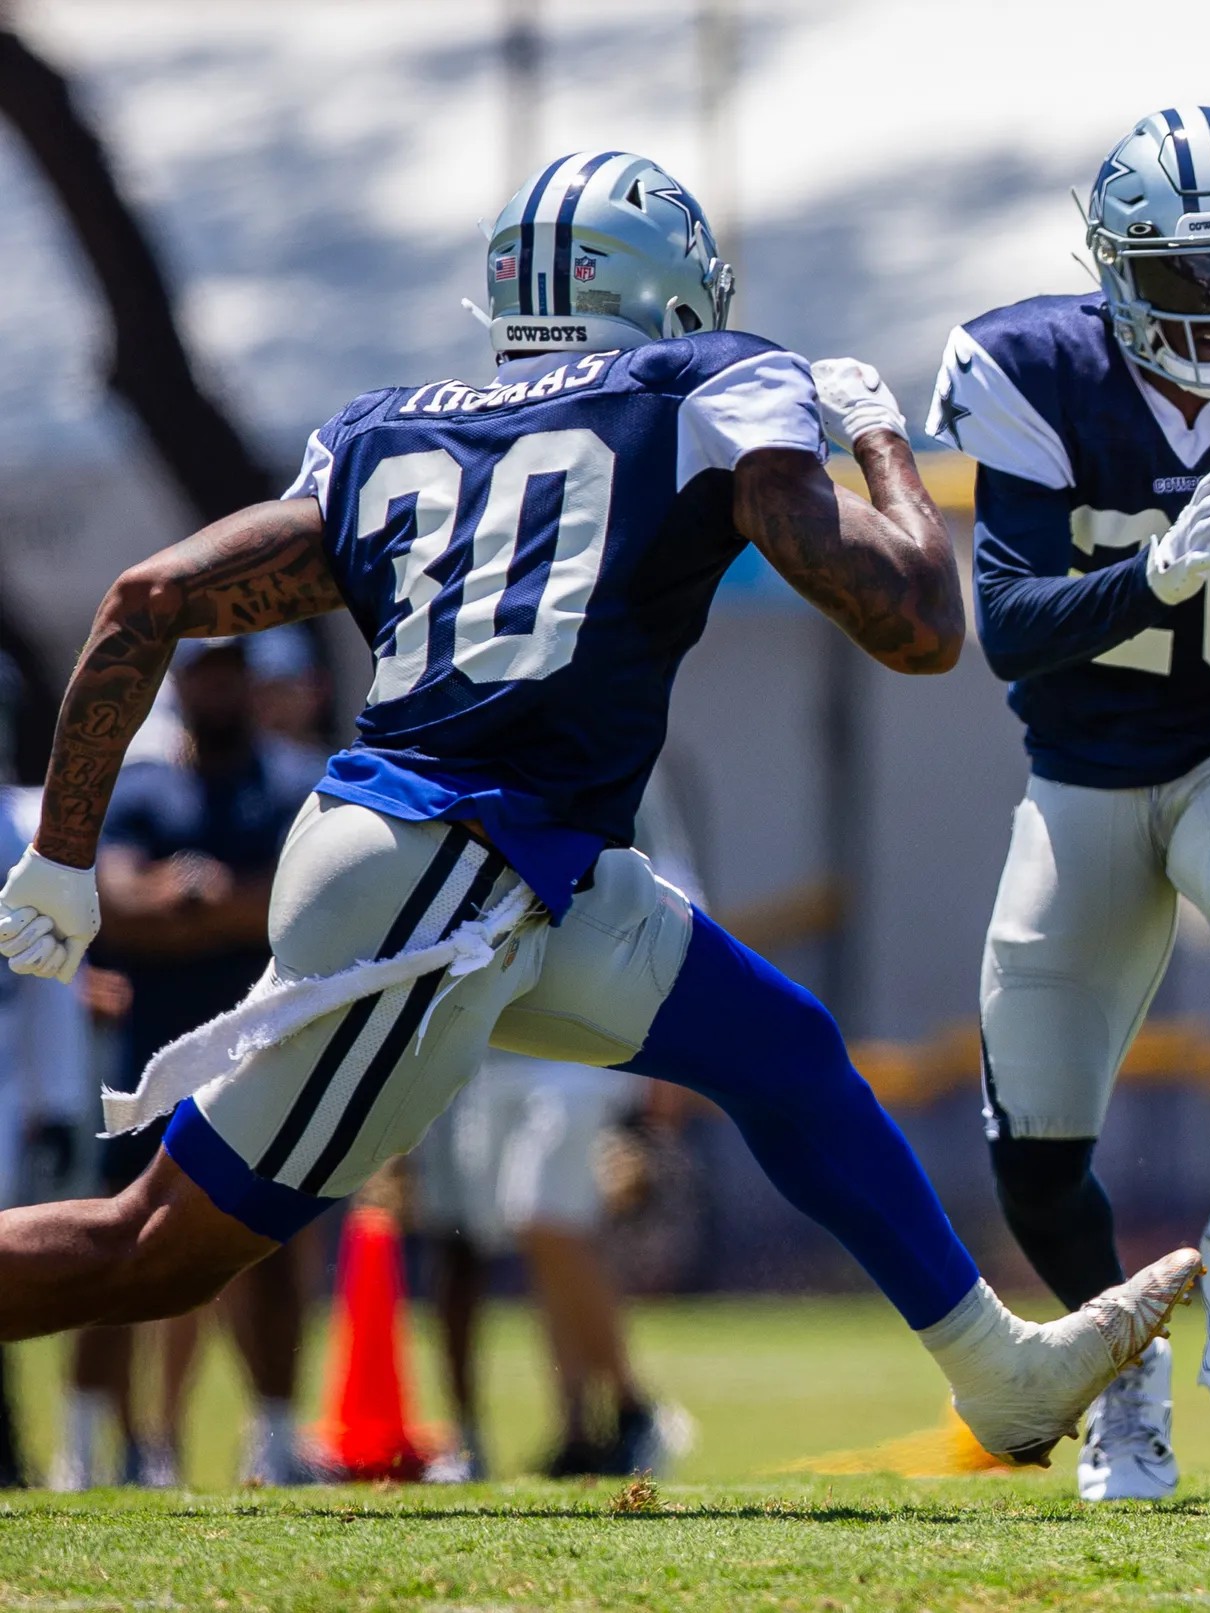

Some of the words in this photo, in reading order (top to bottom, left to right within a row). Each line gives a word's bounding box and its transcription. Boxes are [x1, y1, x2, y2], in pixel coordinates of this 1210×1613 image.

[507, 325, 588, 342] COWBOYS
[399, 349, 621, 413] THOMAS
[1152, 474, 1204, 495] COWB
[357, 428, 616, 706] 30
